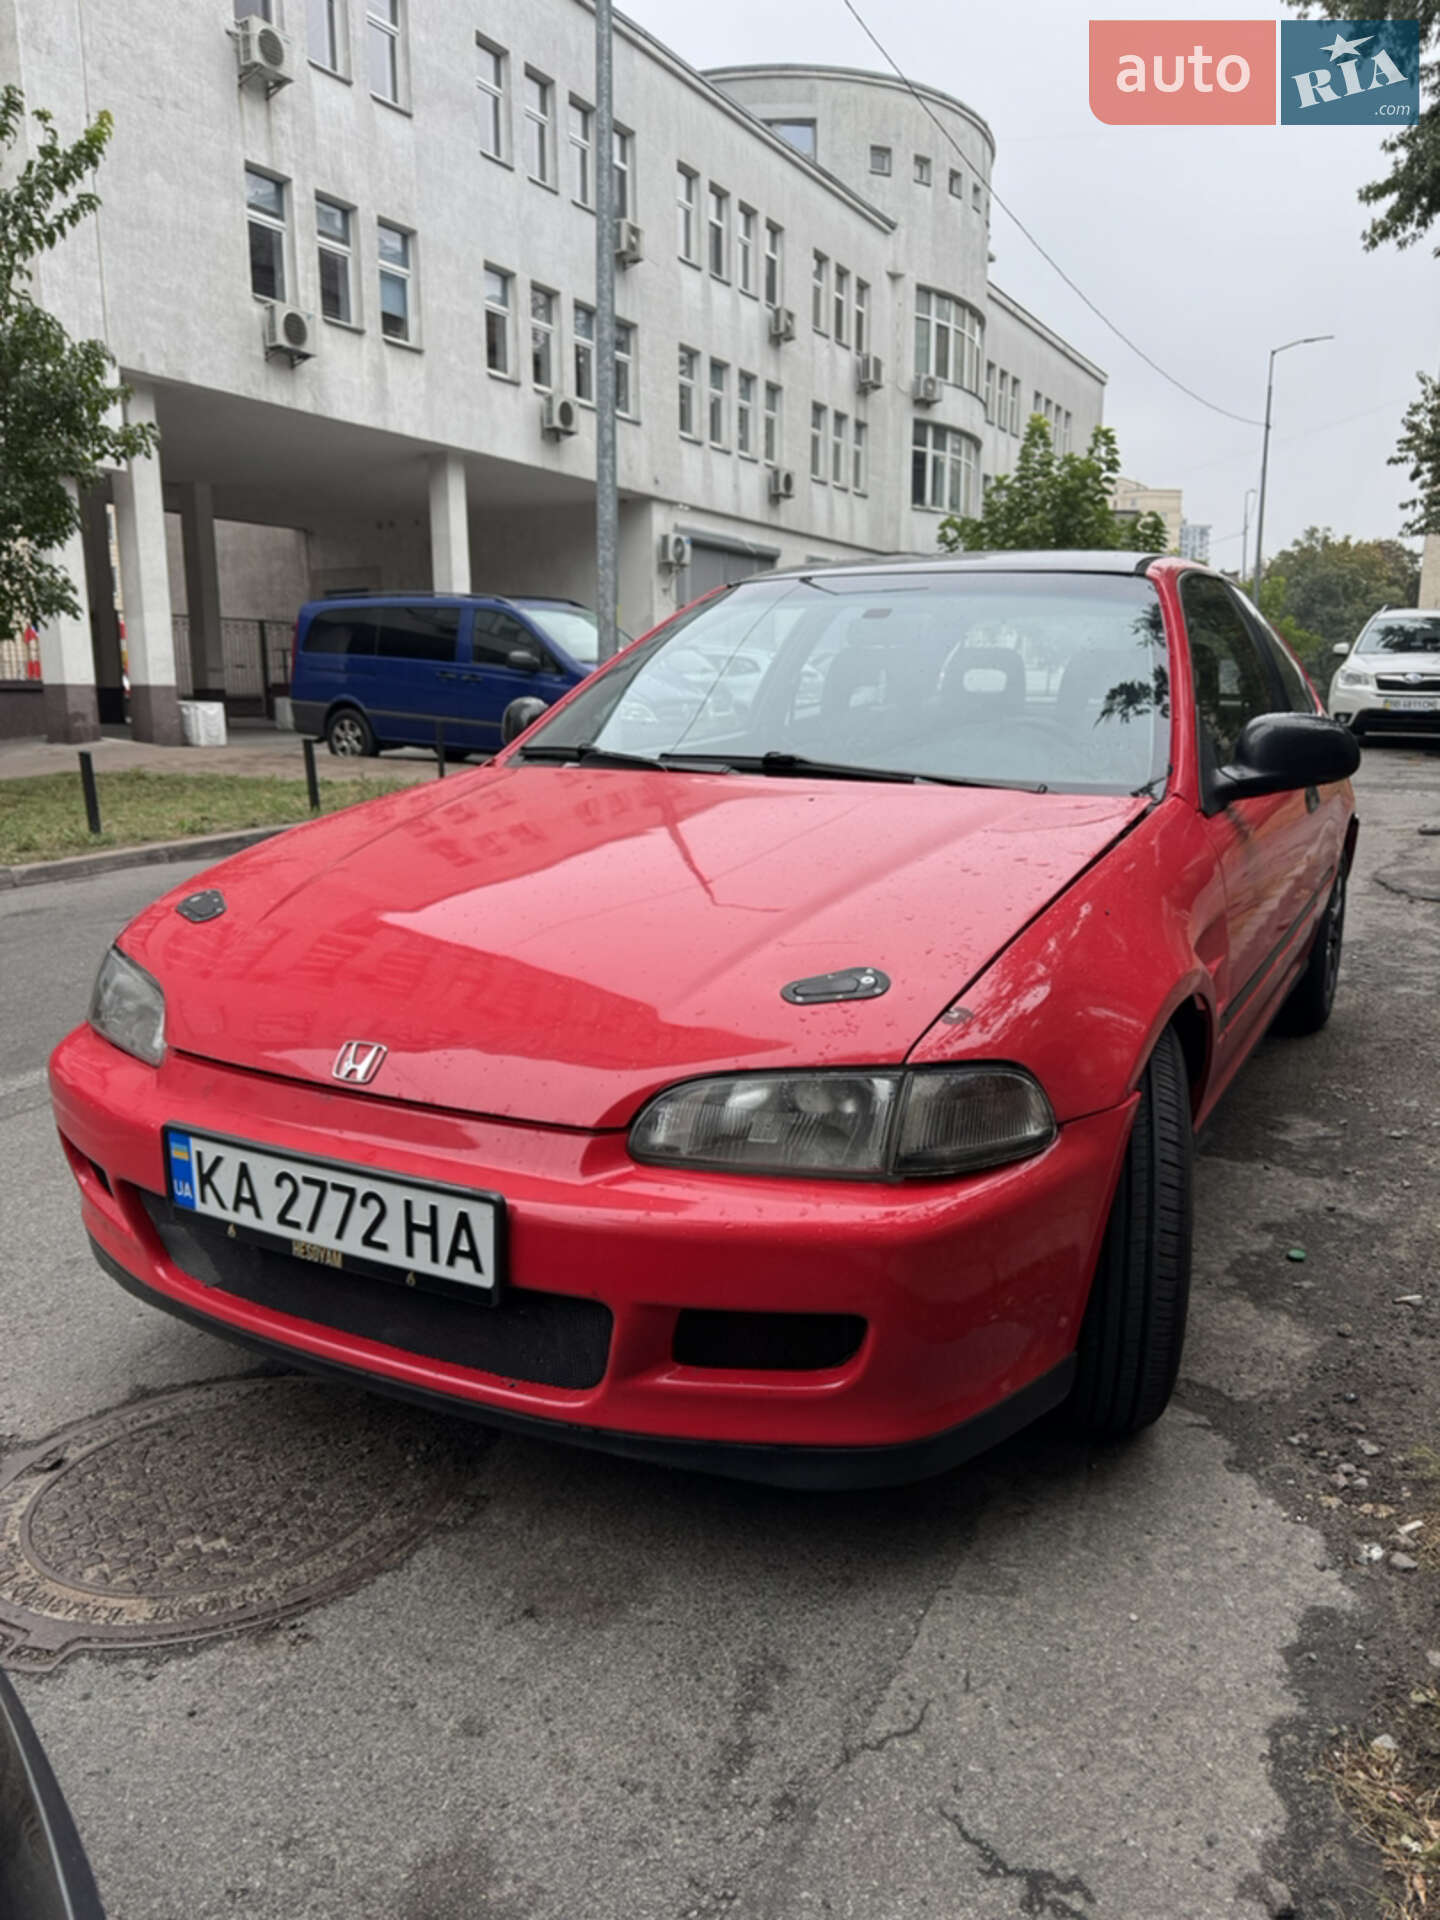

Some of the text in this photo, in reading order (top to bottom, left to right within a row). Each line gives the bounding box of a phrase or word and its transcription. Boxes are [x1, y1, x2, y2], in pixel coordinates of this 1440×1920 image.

[174, 1178, 193, 1200] UA
[195, 1149, 485, 1276] KA 2772 HA
